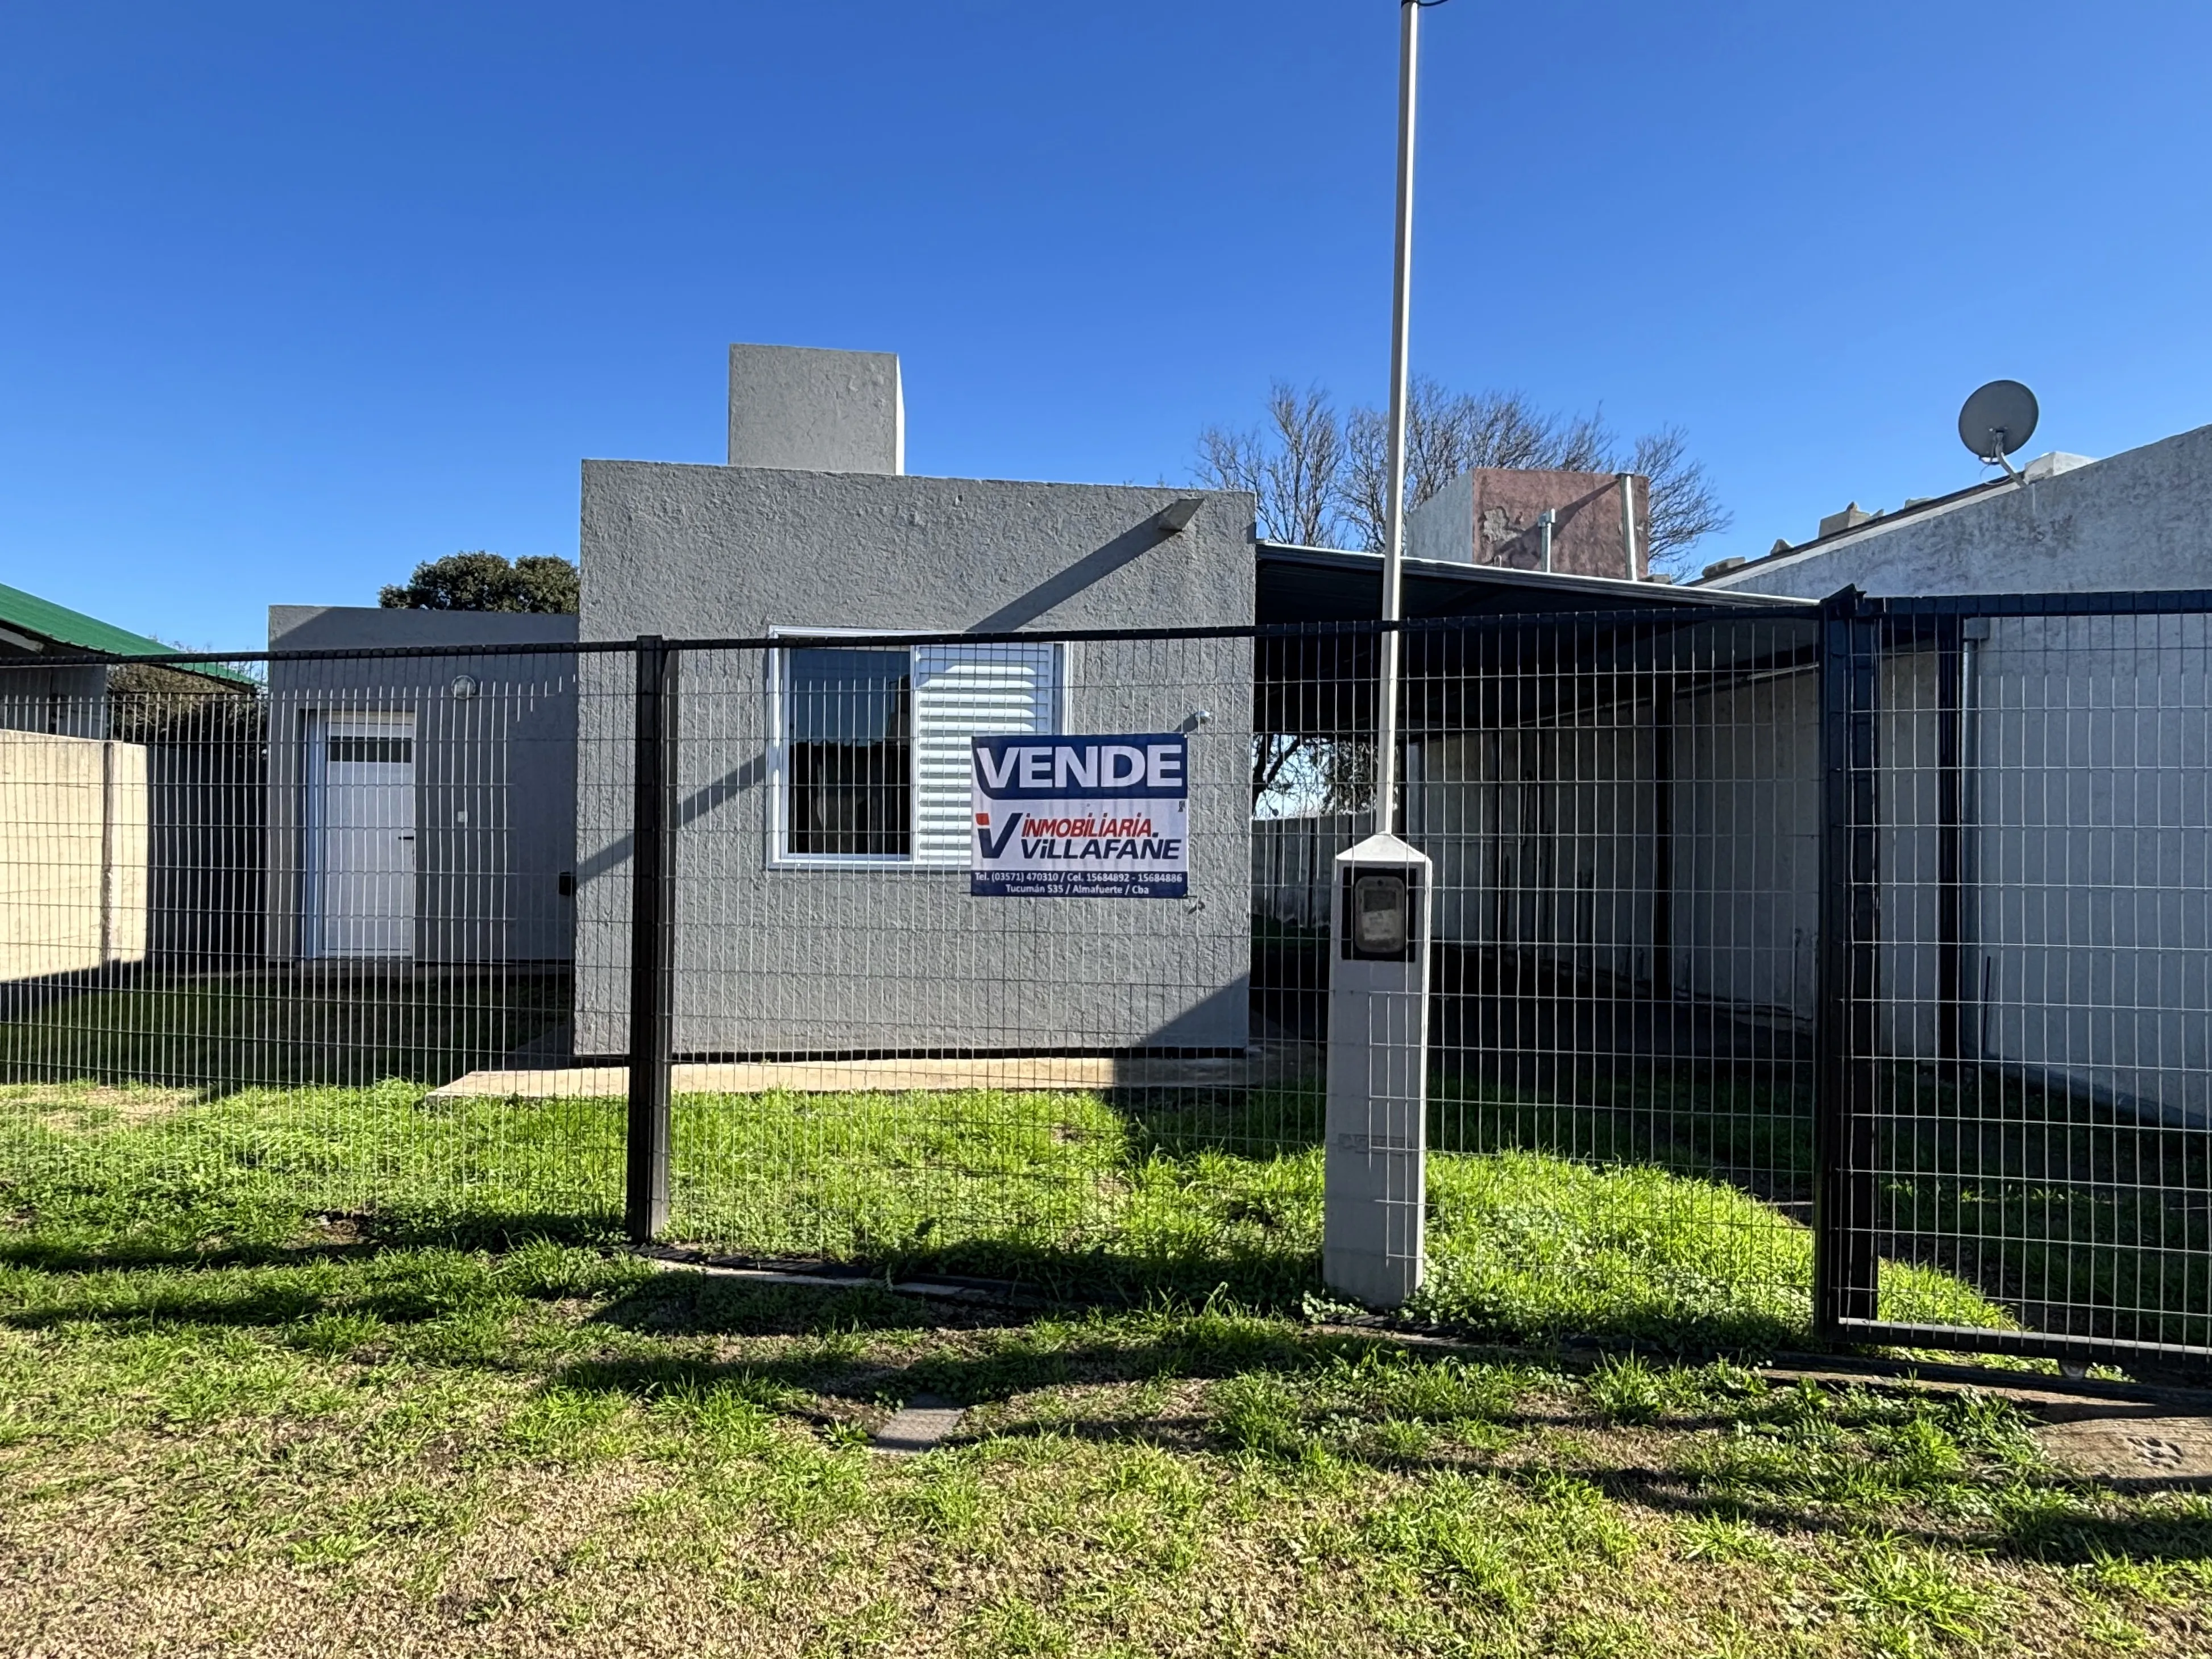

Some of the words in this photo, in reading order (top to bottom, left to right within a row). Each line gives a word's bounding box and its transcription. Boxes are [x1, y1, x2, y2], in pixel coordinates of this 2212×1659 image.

[976, 745, 1182, 789] VENDE
[975, 872, 990, 881] Tel.
[991, 872, 1024, 882] (03571)
[1026, 872, 1059, 881] 470310
[1067, 873, 1084, 882] Cel.
[1086, 873, 1130, 882] 15684892
[1138, 873, 1182, 882] 15684886
[1005, 884, 1045, 893] Tucumán
[1047, 884, 1063, 893] 535
[1072, 884, 1123, 894] Almafuerte
[1132, 885, 1149, 894] Cba
